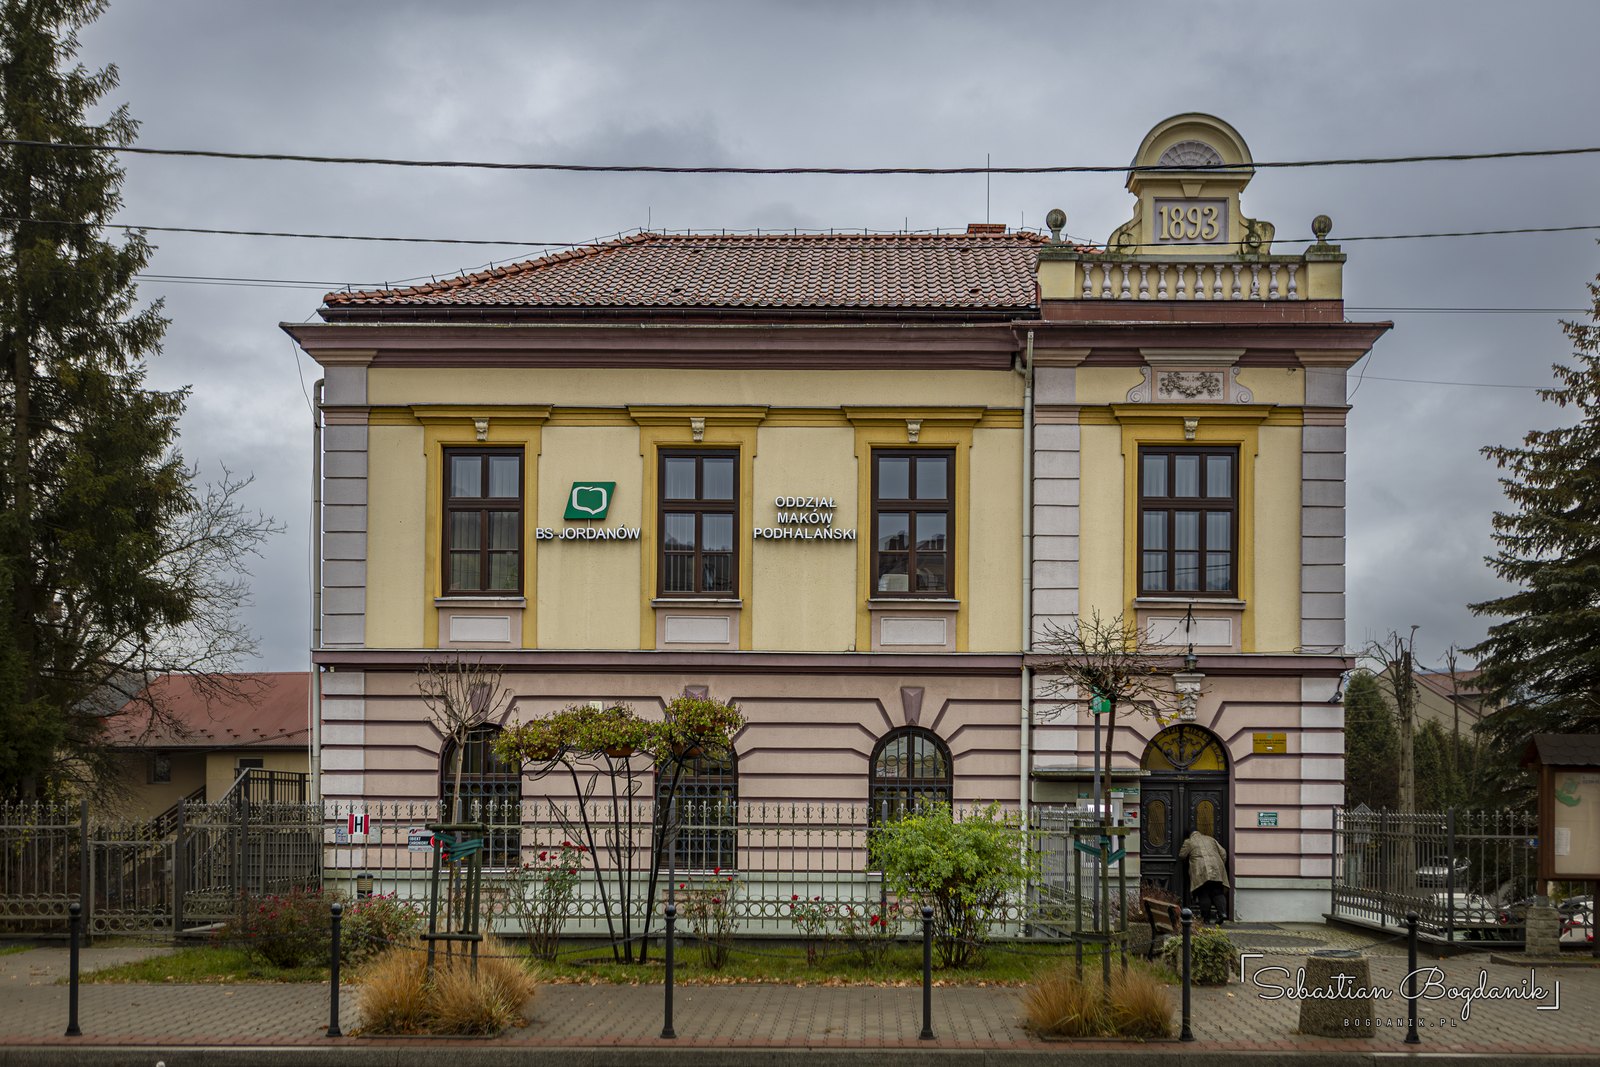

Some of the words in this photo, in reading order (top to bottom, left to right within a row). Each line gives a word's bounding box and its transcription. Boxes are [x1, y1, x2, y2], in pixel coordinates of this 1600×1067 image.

[1159, 206, 1220, 241] 1893
[774, 496, 837, 508] ODDZIAŁ
[777, 509, 834, 525] MAKÓW
[536, 527, 553, 540] BS
[558, 523, 641, 540] JORDANÓW
[753, 524, 857, 541] PODHALAŃSKI
[354, 816, 363, 833] H
